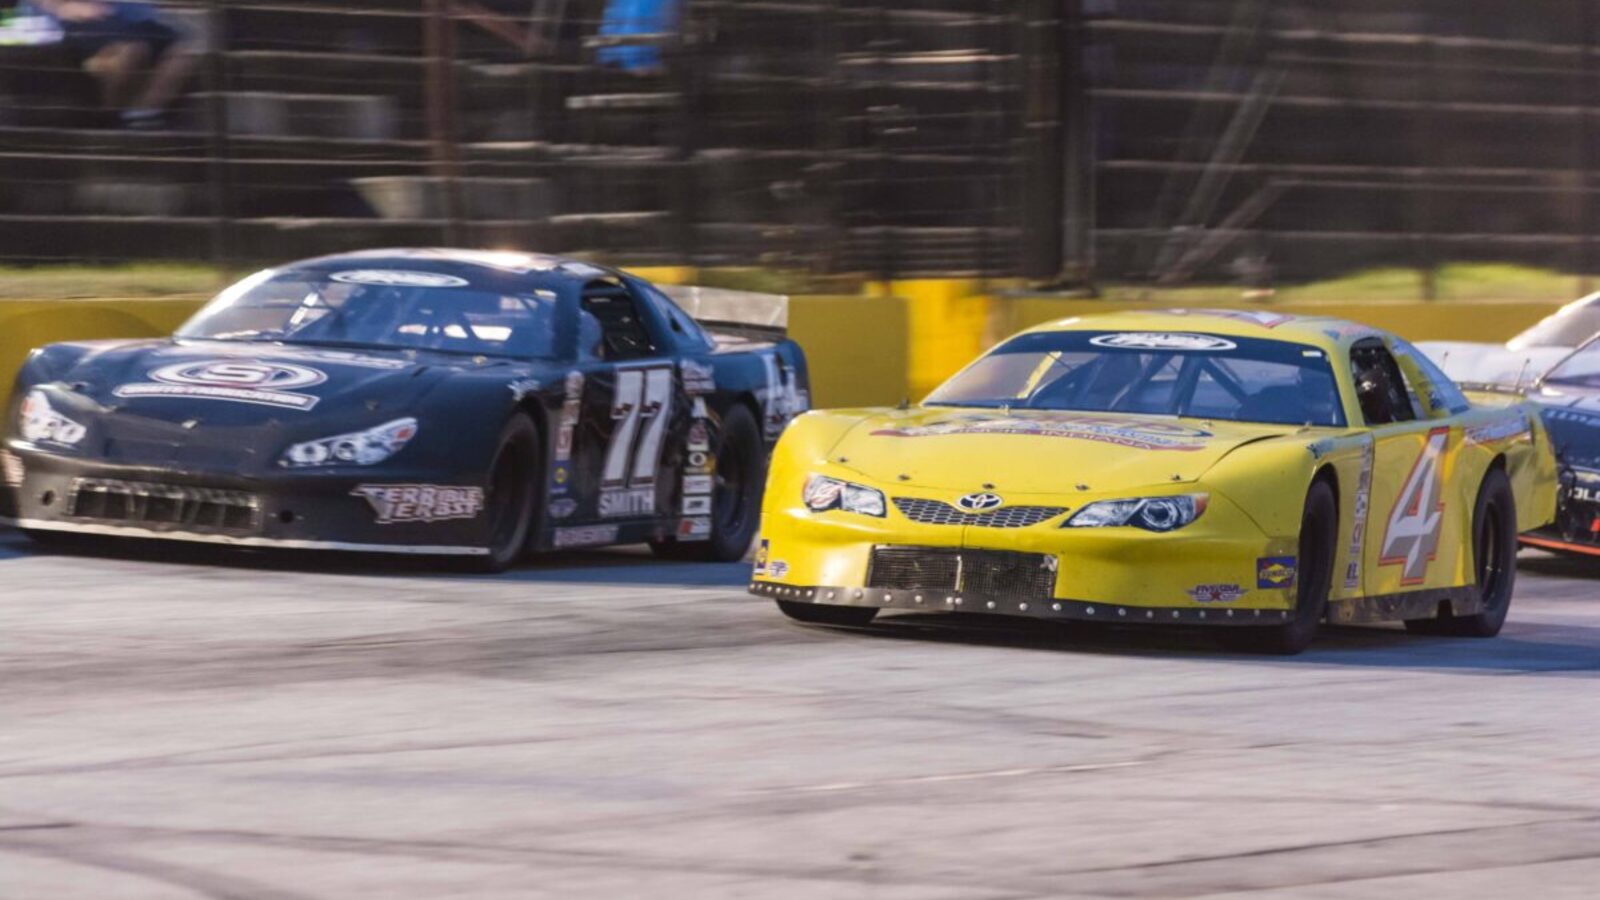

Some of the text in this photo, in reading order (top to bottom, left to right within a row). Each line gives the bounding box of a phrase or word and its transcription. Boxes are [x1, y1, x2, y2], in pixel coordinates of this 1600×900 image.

[604, 365, 672, 488] 77
[1040, 430, 1152, 450] INDIANA
[597, 489, 656, 515] SMITH
[1378, 426, 1450, 586] 4
